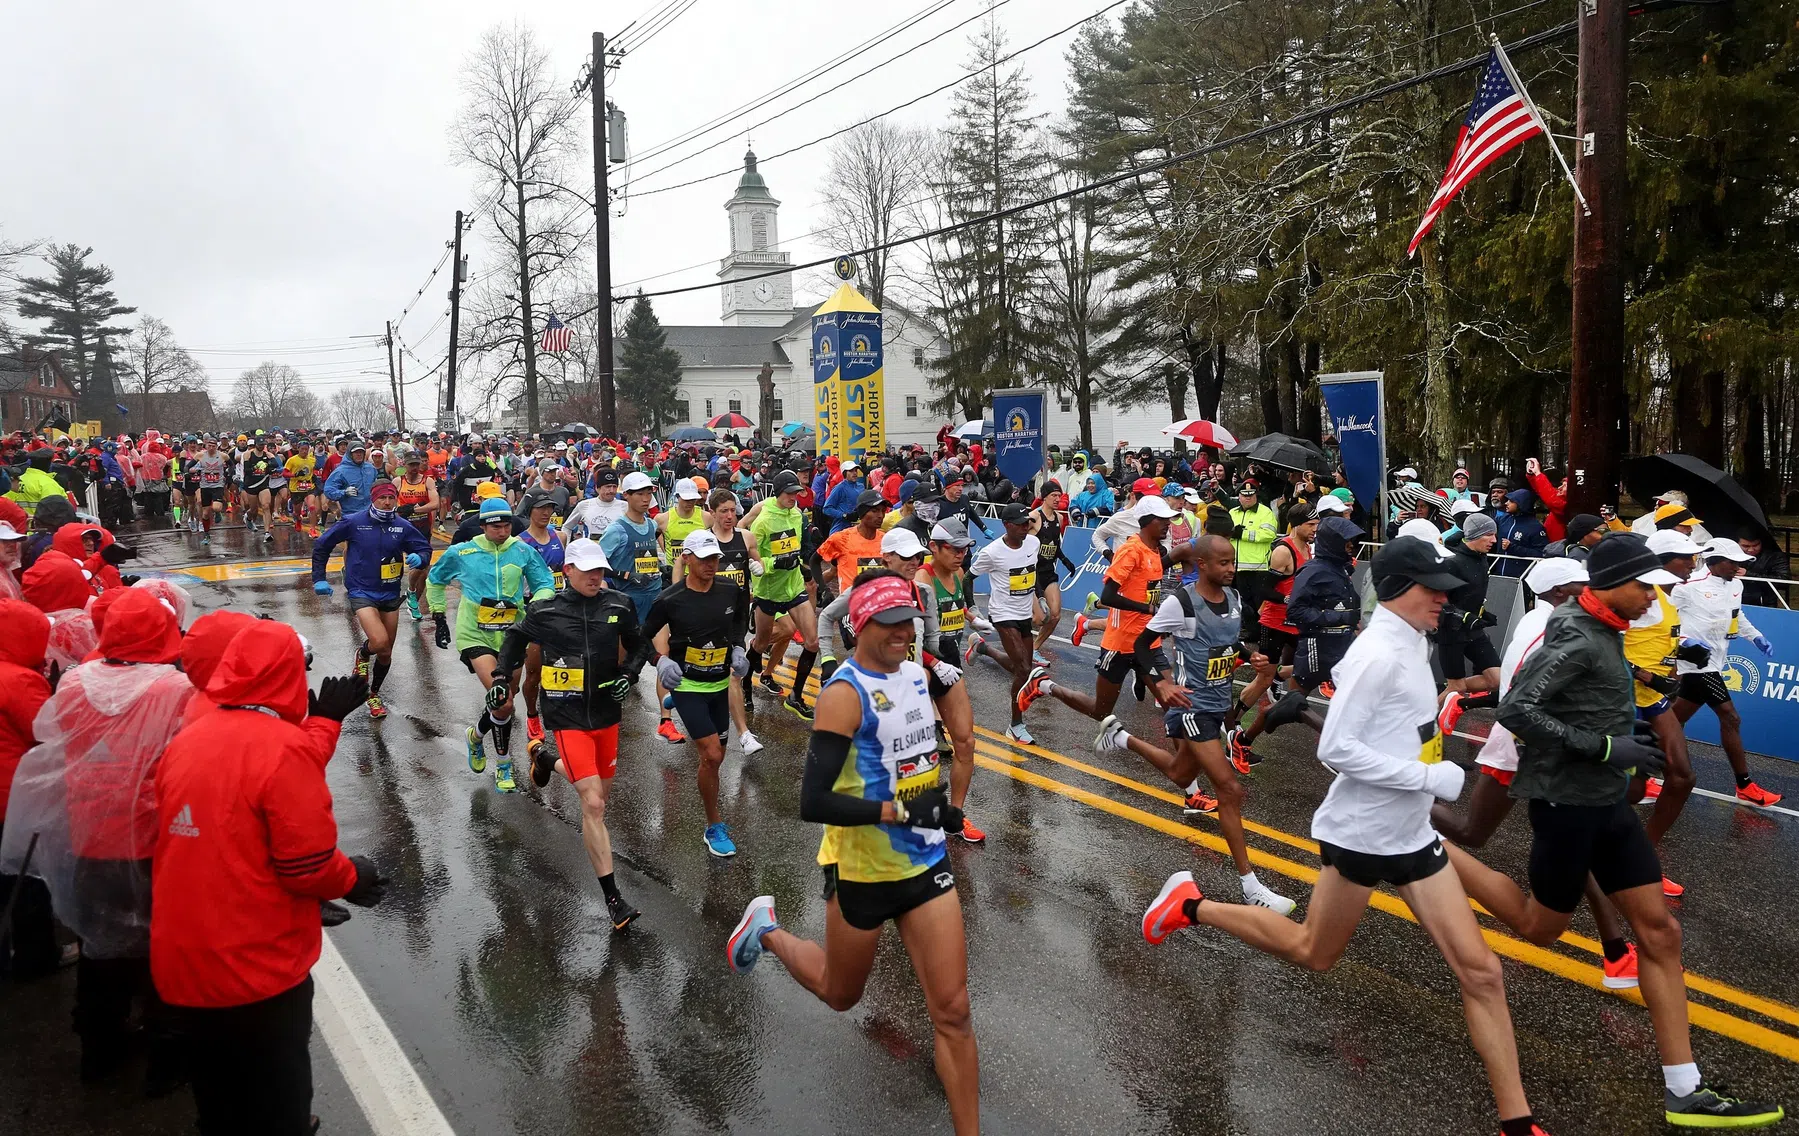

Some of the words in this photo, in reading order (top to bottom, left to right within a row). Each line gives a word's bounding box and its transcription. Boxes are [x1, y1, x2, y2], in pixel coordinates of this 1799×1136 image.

[443, 421, 455, 429] 85
[1336, 416, 1349, 444] John
[1347, 414, 1377, 436] Hancock
[1576, 475, 1585, 486] 2
[780, 540, 792, 550] 24
[1022, 576, 1028, 585] 4
[490, 609, 505, 619] 44
[698, 651, 715, 662] 31
[552, 670, 570, 685] 19
[893, 737, 905, 752] EL
[168, 824, 200, 838] adidas
